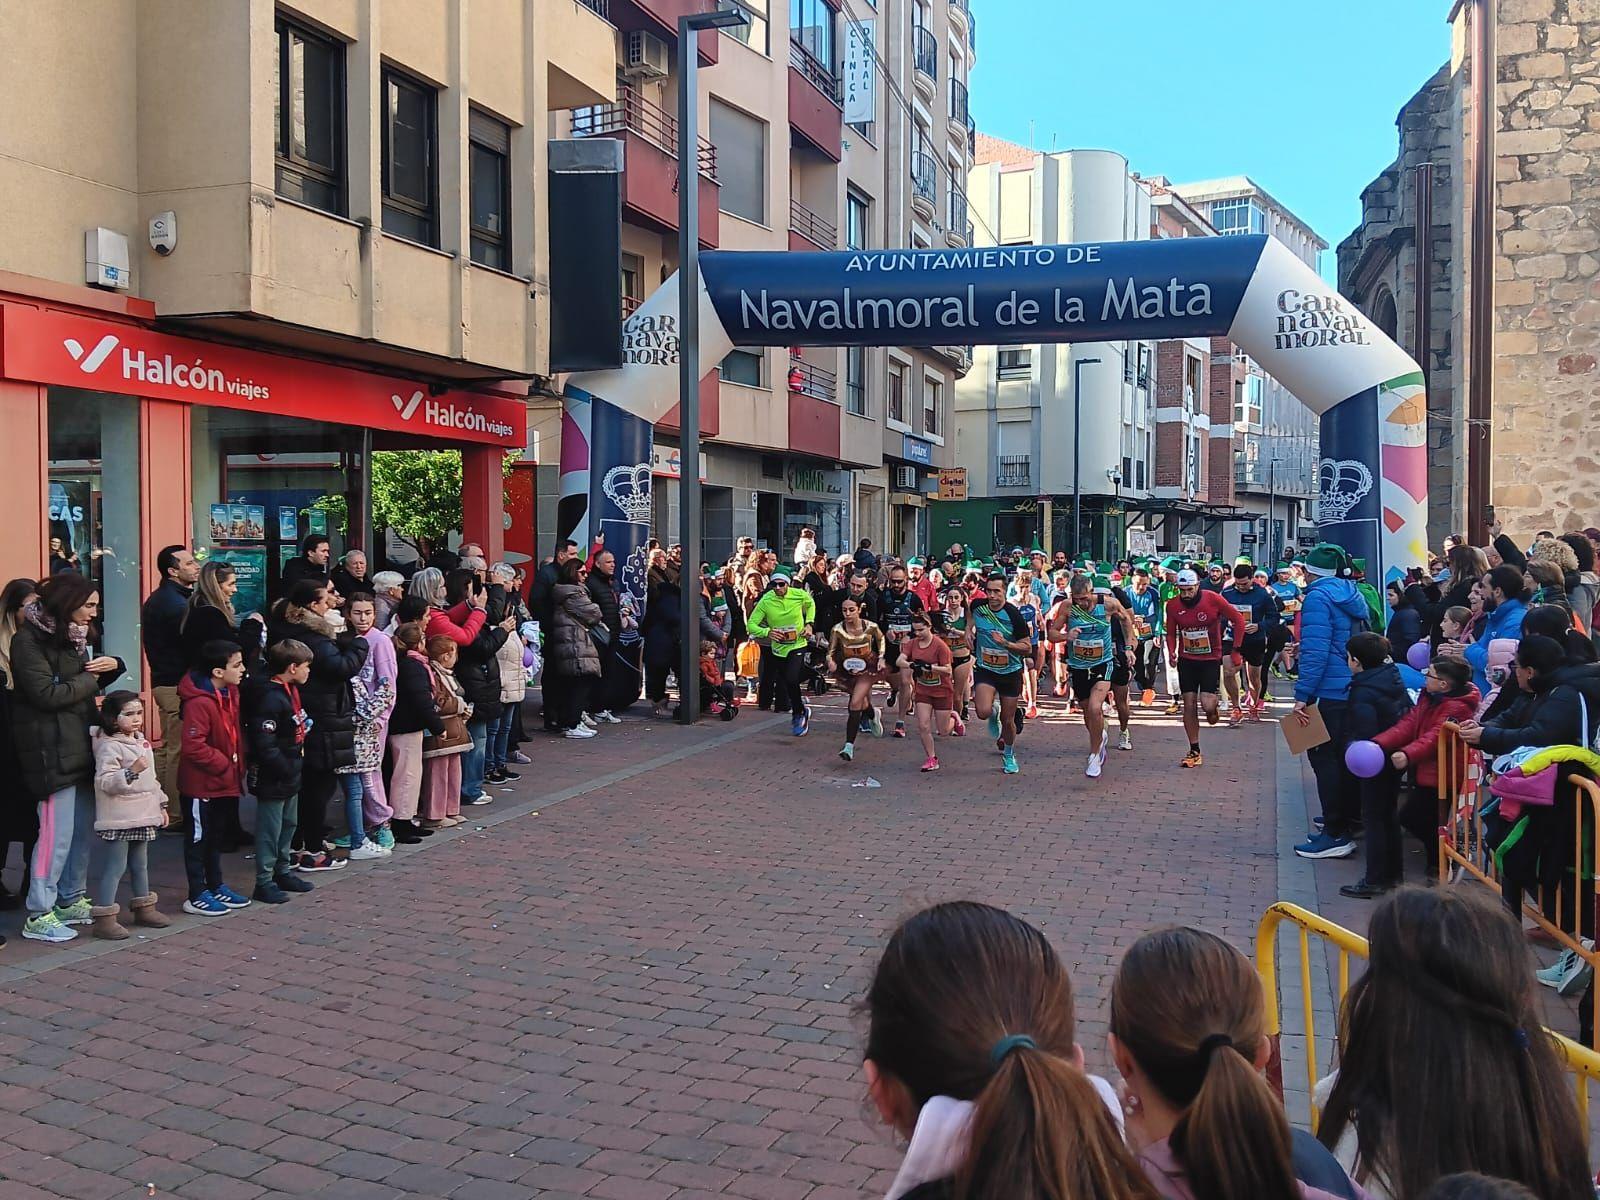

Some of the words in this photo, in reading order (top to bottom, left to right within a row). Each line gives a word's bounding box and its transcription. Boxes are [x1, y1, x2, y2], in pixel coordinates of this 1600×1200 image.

[845, 248, 1055, 272] AYUNTAMIENTO
[1066, 246, 1101, 264] DE
[740, 284, 980, 330] Navalmoral
[995, 290, 1040, 326] de
[1054, 288, 1086, 324] la
[1100, 277, 1212, 321] Mata
[122, 347, 225, 393] Halcón
[226, 377, 270, 401] viajes
[425, 400, 486, 432] Halcón
[486, 420, 513, 437] viajes
